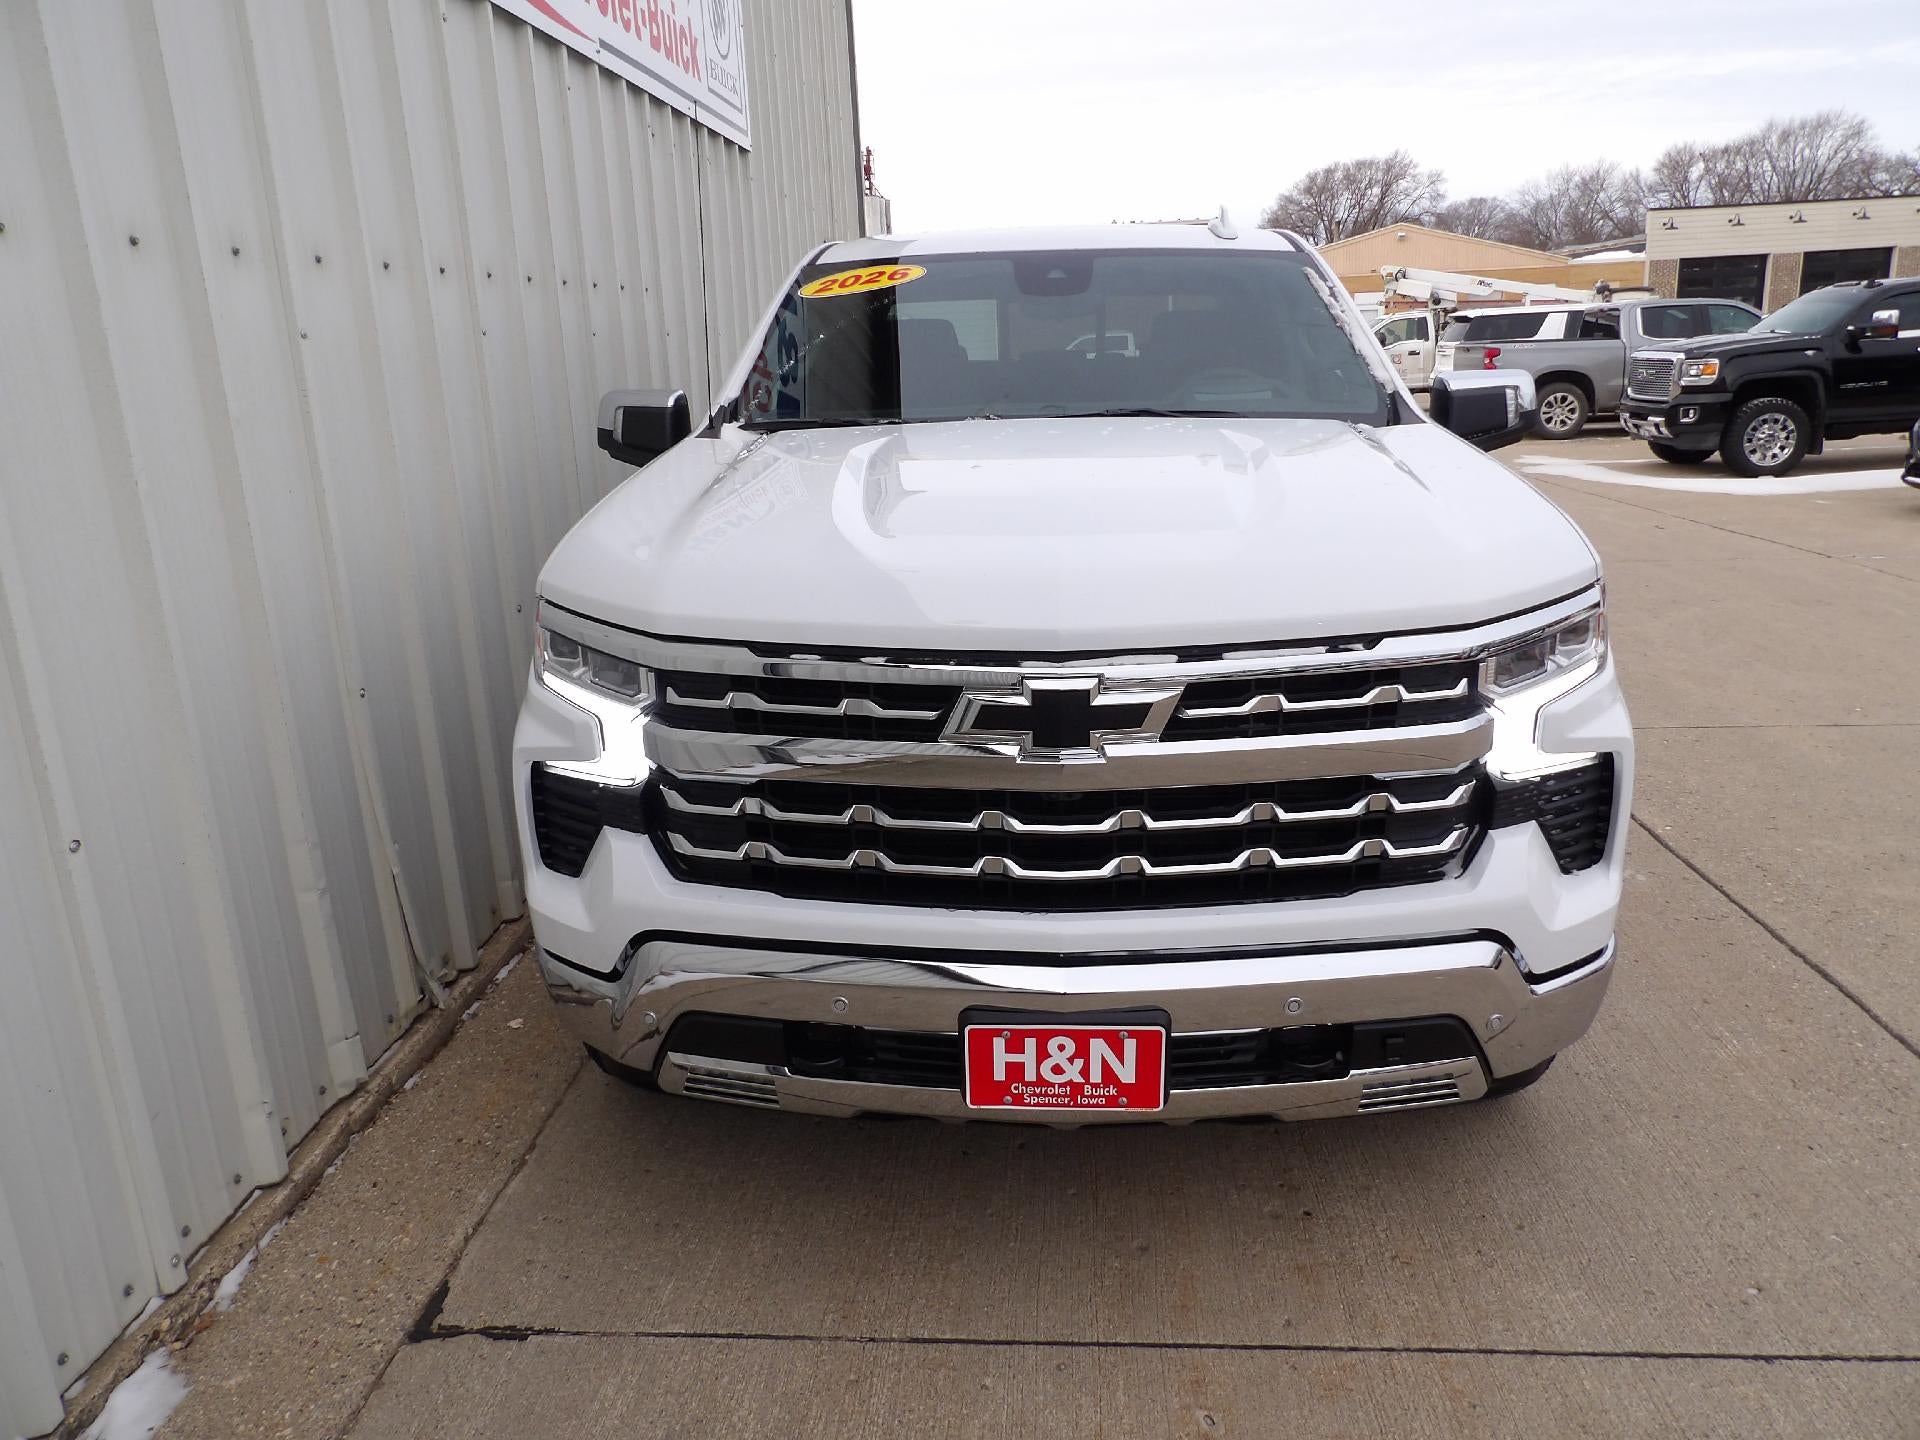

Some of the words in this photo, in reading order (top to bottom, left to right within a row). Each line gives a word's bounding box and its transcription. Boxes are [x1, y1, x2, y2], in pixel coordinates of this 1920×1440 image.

[708, 57, 739, 97] BUICK
[811, 267, 912, 295] 2026
[992, 1035, 1137, 1084] H&N
[1010, 1083, 1071, 1095] Chevrolet
[1084, 1084, 1117, 1096] Buick
[1023, 1094, 1075, 1106] Spencer,
[1077, 1094, 1106, 1105] Iowa
